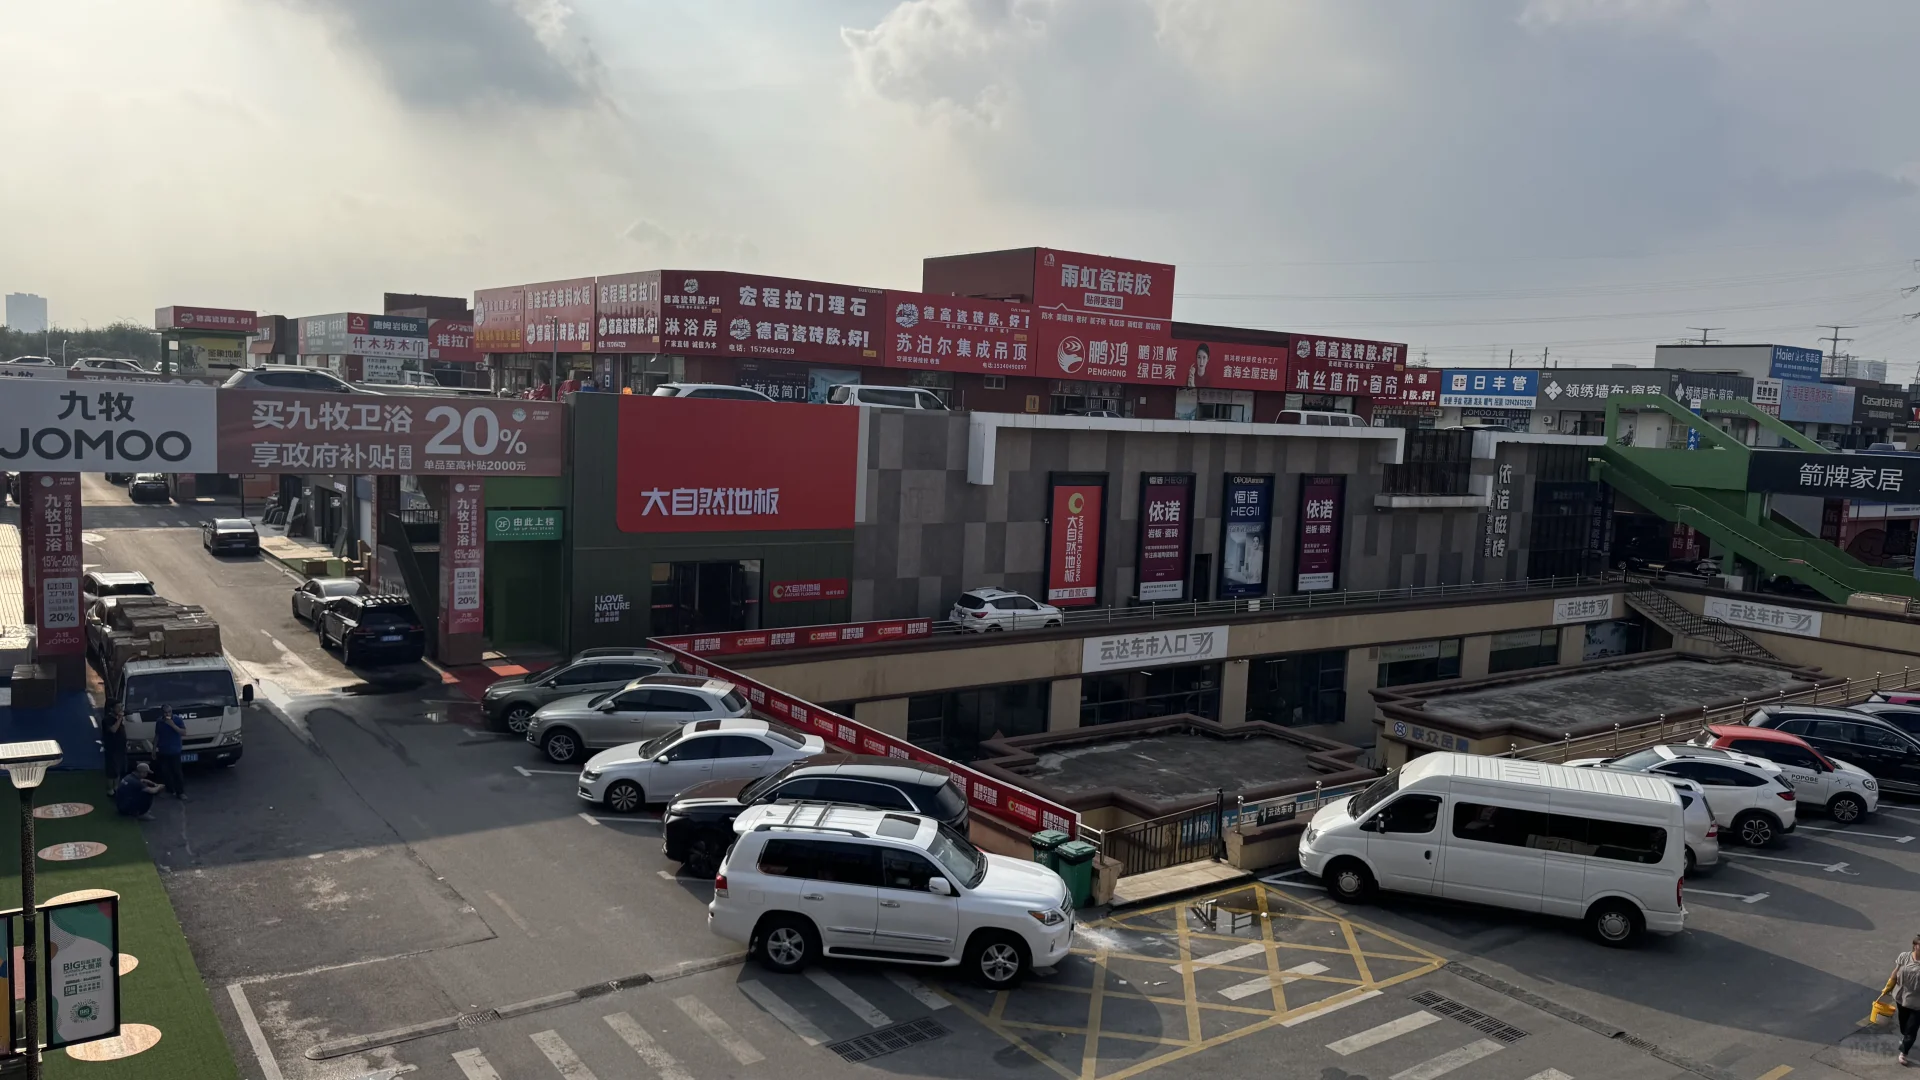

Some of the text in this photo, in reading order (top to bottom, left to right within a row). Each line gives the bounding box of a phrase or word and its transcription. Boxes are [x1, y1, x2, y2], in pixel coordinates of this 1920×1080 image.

[1061, 264, 1151, 296] 雨虹瓷砖胶
[739, 285, 867, 317] 宏程拉门理石
[1085, 294, 1122, 308] 贴得更牢固
[1041, 311, 1053, 320] 防水
[665, 317, 718, 337] 淋浴房
[353, 336, 425, 353] 什木坊木门
[896, 333, 1028, 362] 苏泊尔集成吊顶
[1088, 340, 1128, 366] 鹏鸿
[1137, 344, 1178, 362] 鹏鸿板
[1775, 347, 1795, 361] Haier
[1088, 367, 1126, 377] PENGHONG
[1137, 362, 1177, 380] 绿色家
[1223, 366, 1278, 381] 鑫海全屋定制
[1296, 369, 1398, 395] 沐丝墙布·窗帘
[1474, 375, 1527, 391] 日丰管
[57, 390, 135, 423] 九牧
[1862, 394, 1889, 407] Casarte
[252, 400, 414, 433] 买九牧卫浴
[425, 405, 527, 456] 20%
[0, 427, 192, 462] JOMOO
[251, 442, 395, 470] 享政府补贴
[424, 460, 526, 472] 单品至高补贴2000元
[1800, 462, 1904, 492] 箭牌家居
[640, 487, 780, 517] 大自然地板
[1234, 490, 1258, 504] 恒洁
[1148, 500, 1181, 522] 依诺
[1230, 506, 1260, 516] HEGII
[1306, 499, 1334, 519] 依诺
[1492, 463, 1512, 558] 依诺磁砖
[44, 493, 62, 552] 九牧卫浴
[457, 498, 469, 547] 九牧卫浴
[498, 517, 555, 528] 2F 由此上楼
[1305, 525, 1332, 534] 岩板·瓷砖
[1147, 528, 1179, 538] 岩板·瓷砖
[1064, 515, 1078, 583] 大自然地板
[42, 555, 79, 568] 15%-20%
[784, 583, 821, 593] 大自然地板
[1055, 588, 1088, 598] 工厂直营店
[458, 596, 477, 605] 20%
[594, 594, 624, 604] I LOVE
[594, 602, 631, 612] NATURE
[1568, 600, 1595, 616] 云达车市
[1729, 603, 1785, 624] 云达车市
[49, 613, 76, 623] 20%
[45, 637, 79, 645] JOMOO
[1100, 634, 1187, 661] 云达车市入口
[1267, 804, 1294, 818] 云达车市
[63, 960, 80, 971] BIG
